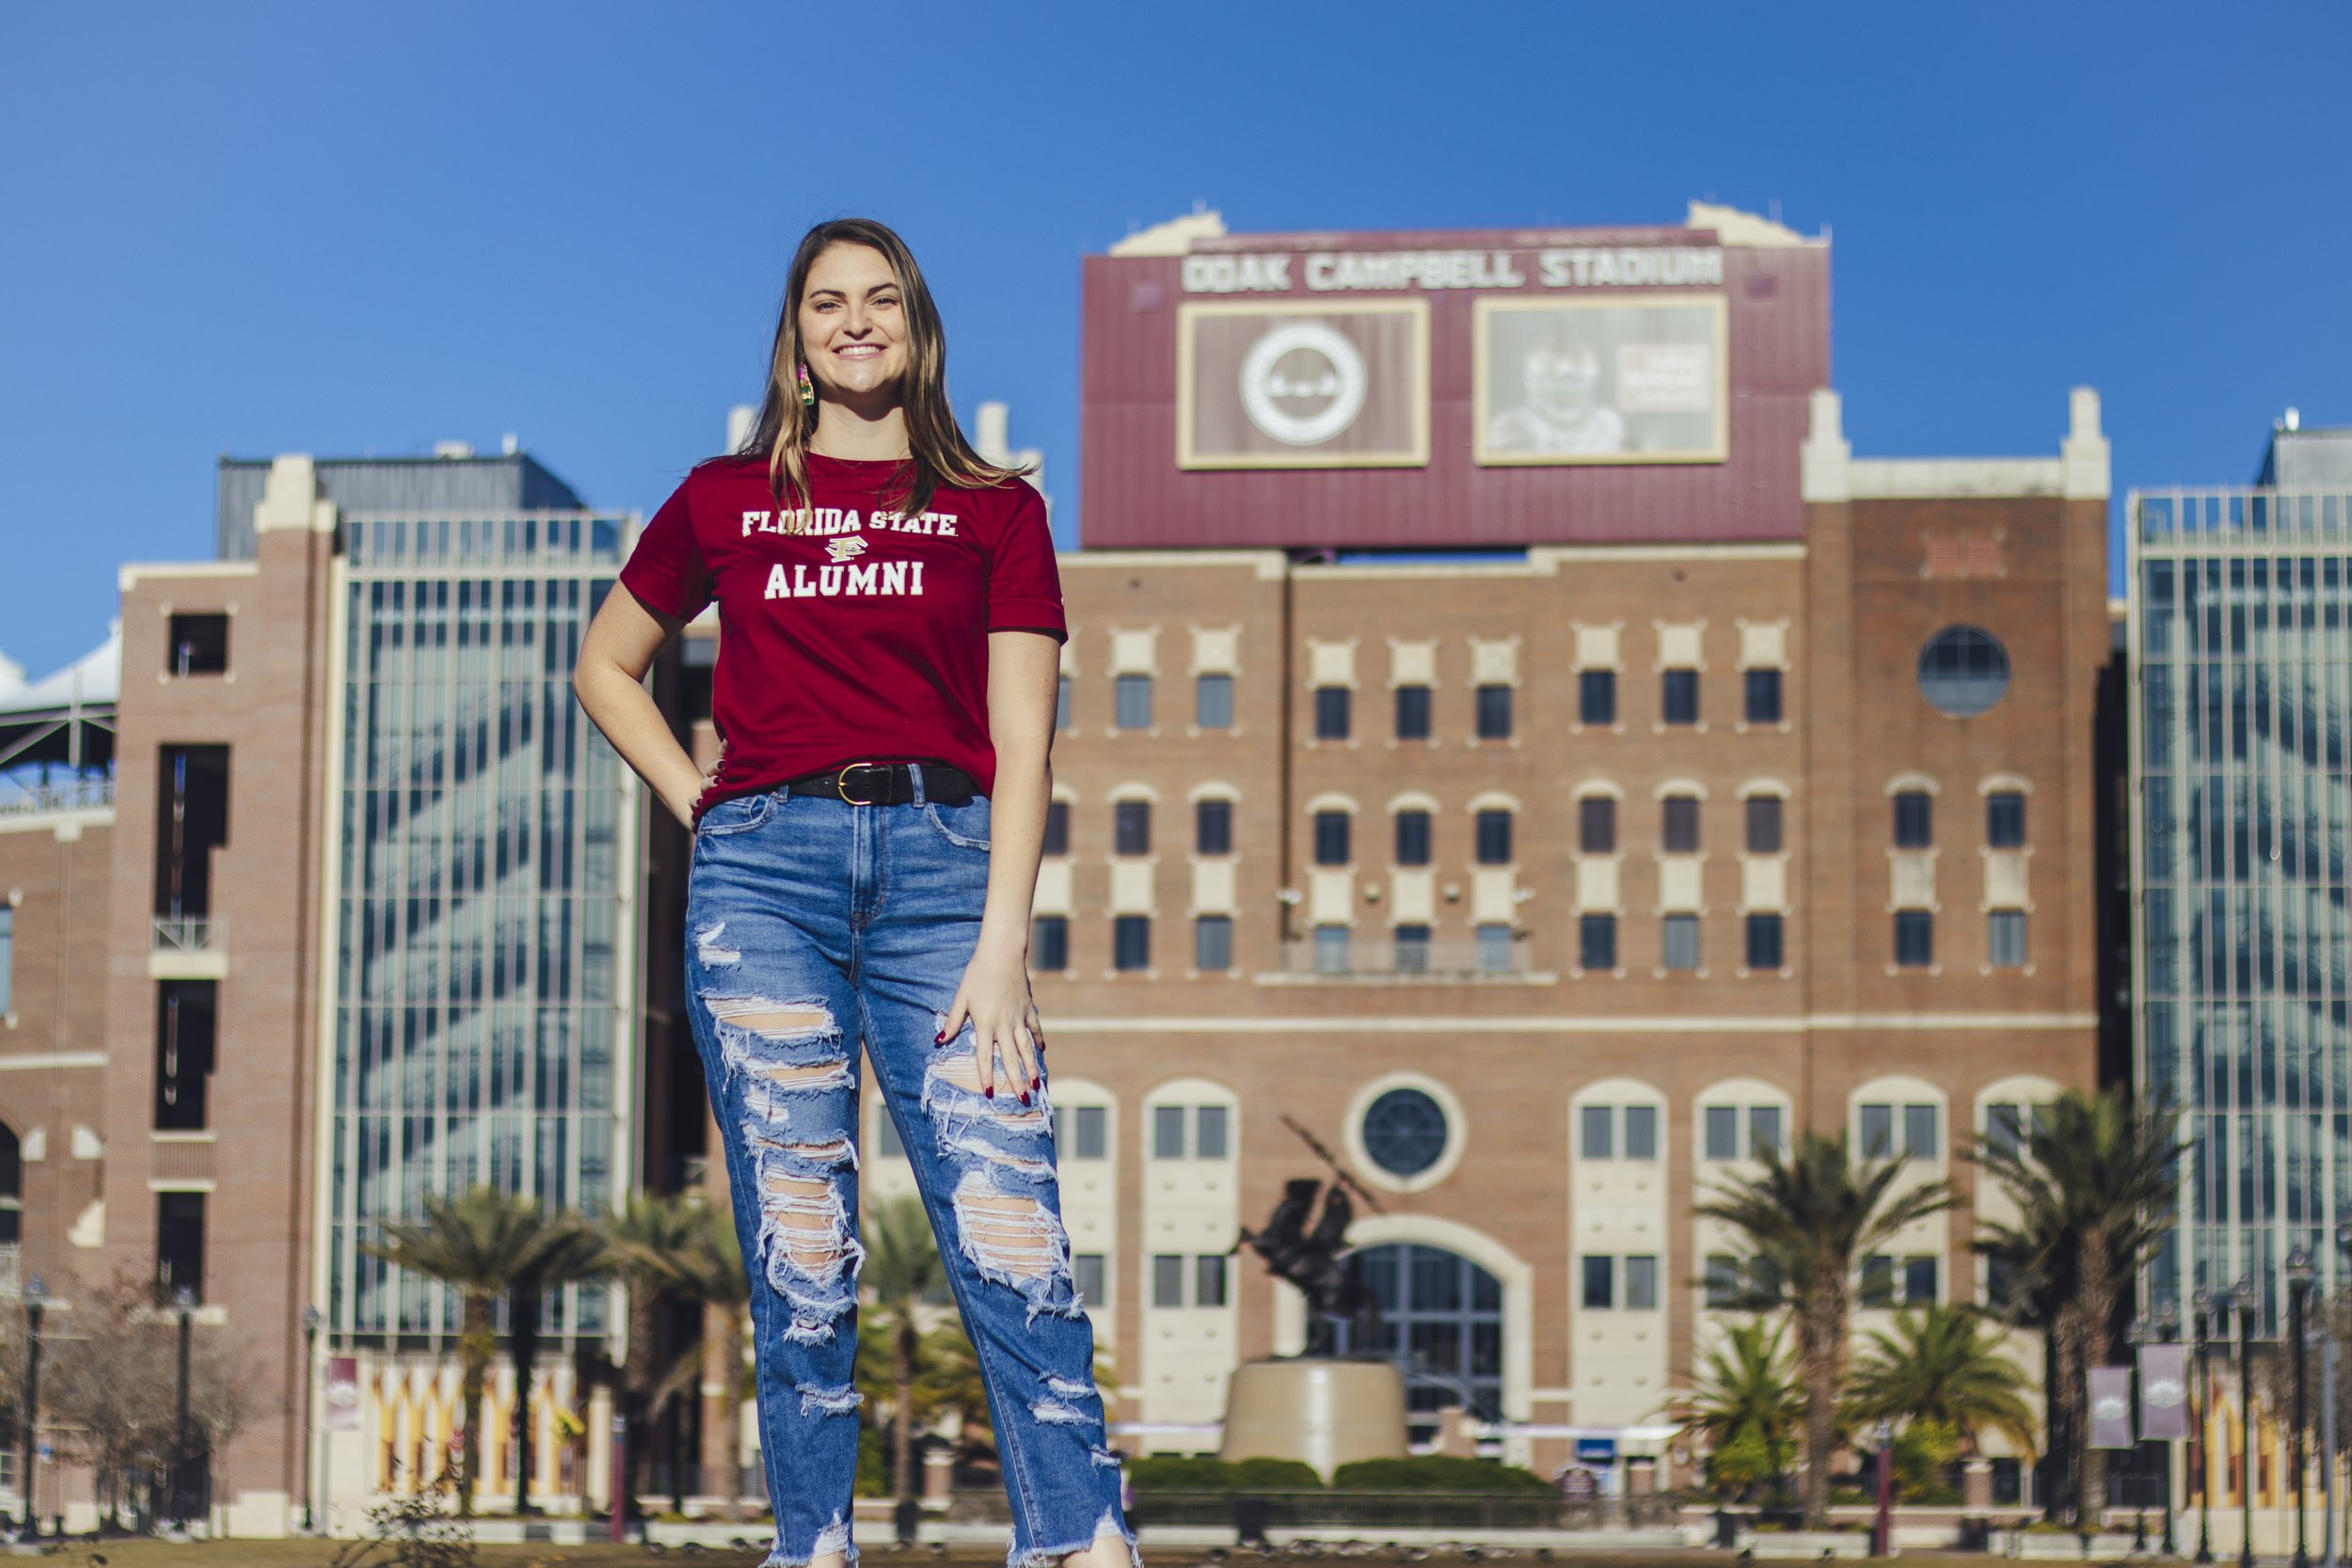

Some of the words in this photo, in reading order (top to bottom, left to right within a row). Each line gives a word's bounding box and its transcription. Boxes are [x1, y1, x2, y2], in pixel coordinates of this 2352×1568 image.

[1182, 253, 1293, 293] DOAK
[1304, 251, 1526, 292] CAMPBELL
[1539, 247, 1724, 287] STADIUM
[742, 509, 862, 537] FLORIDA
[868, 511, 958, 536] STATE
[765, 562, 924, 599] ALUMNI
